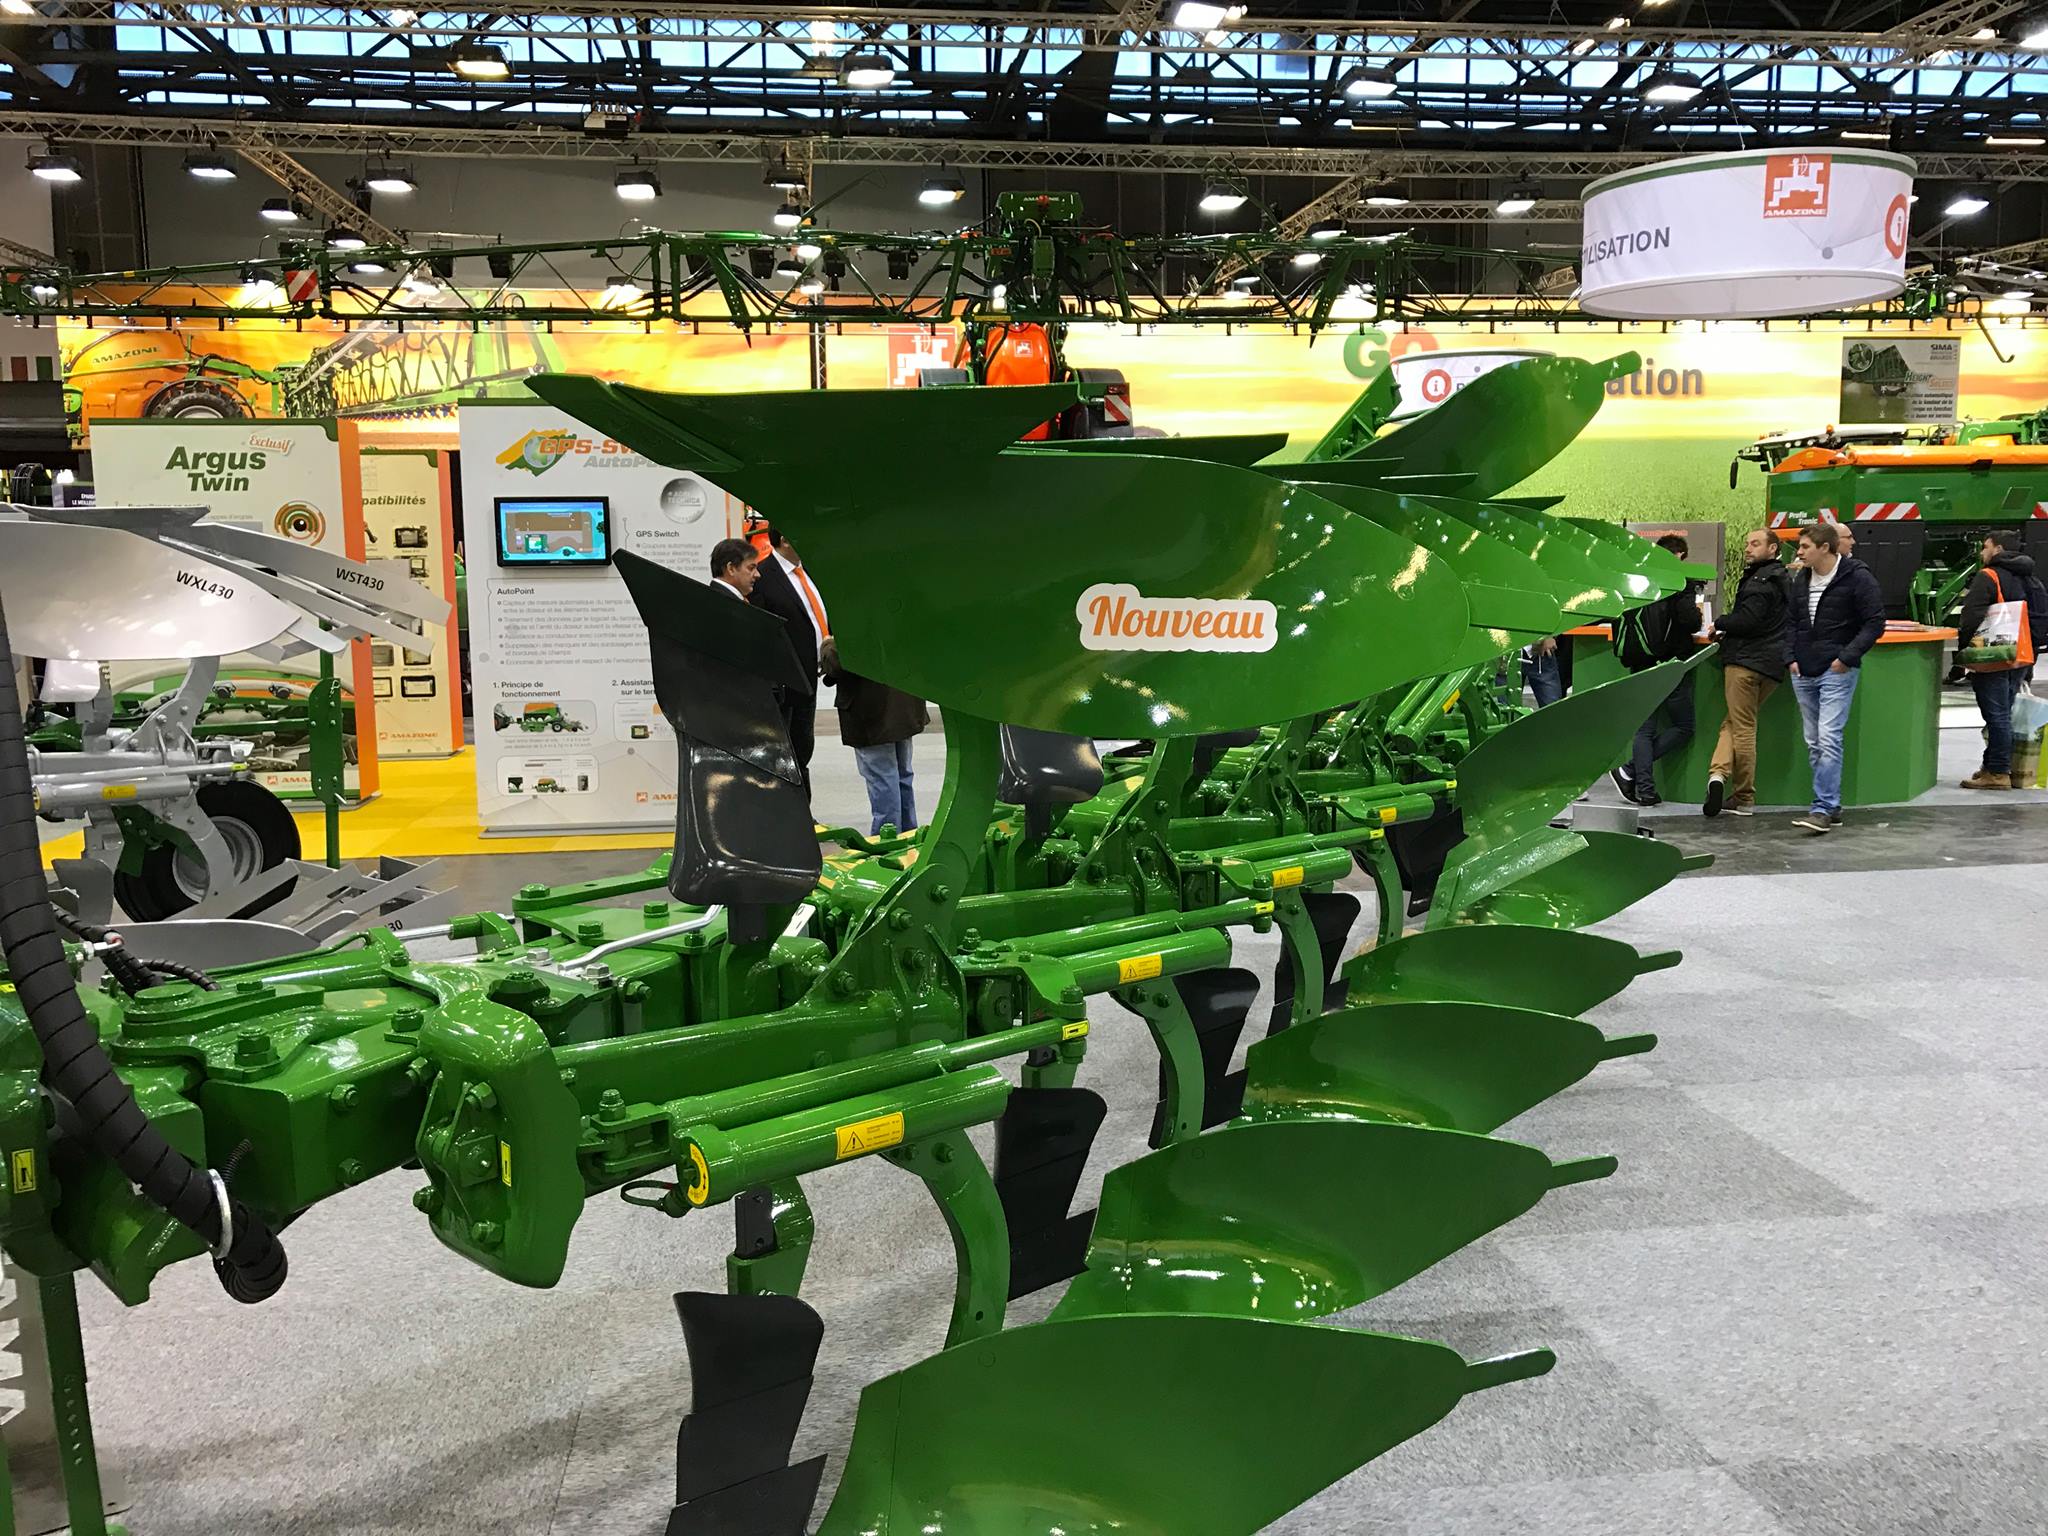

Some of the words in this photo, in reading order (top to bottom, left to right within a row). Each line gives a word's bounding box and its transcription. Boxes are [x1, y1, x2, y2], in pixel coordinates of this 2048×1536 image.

[1764, 208, 1826, 217] AMAZONE
[249, 434, 293, 454] Exclusif
[165, 446, 267, 475] Argus
[187, 472, 250, 492] Twin
[635, 530, 653, 538] GPS
[654, 530, 680, 538] Switch
[176, 569, 235, 600] WXL430
[336, 567, 385, 591] WST430
[497, 587, 535, 595] AutoPoint
[1088, 595, 1265, 639] Nouveau
[501, 681, 532, 689] Principe
